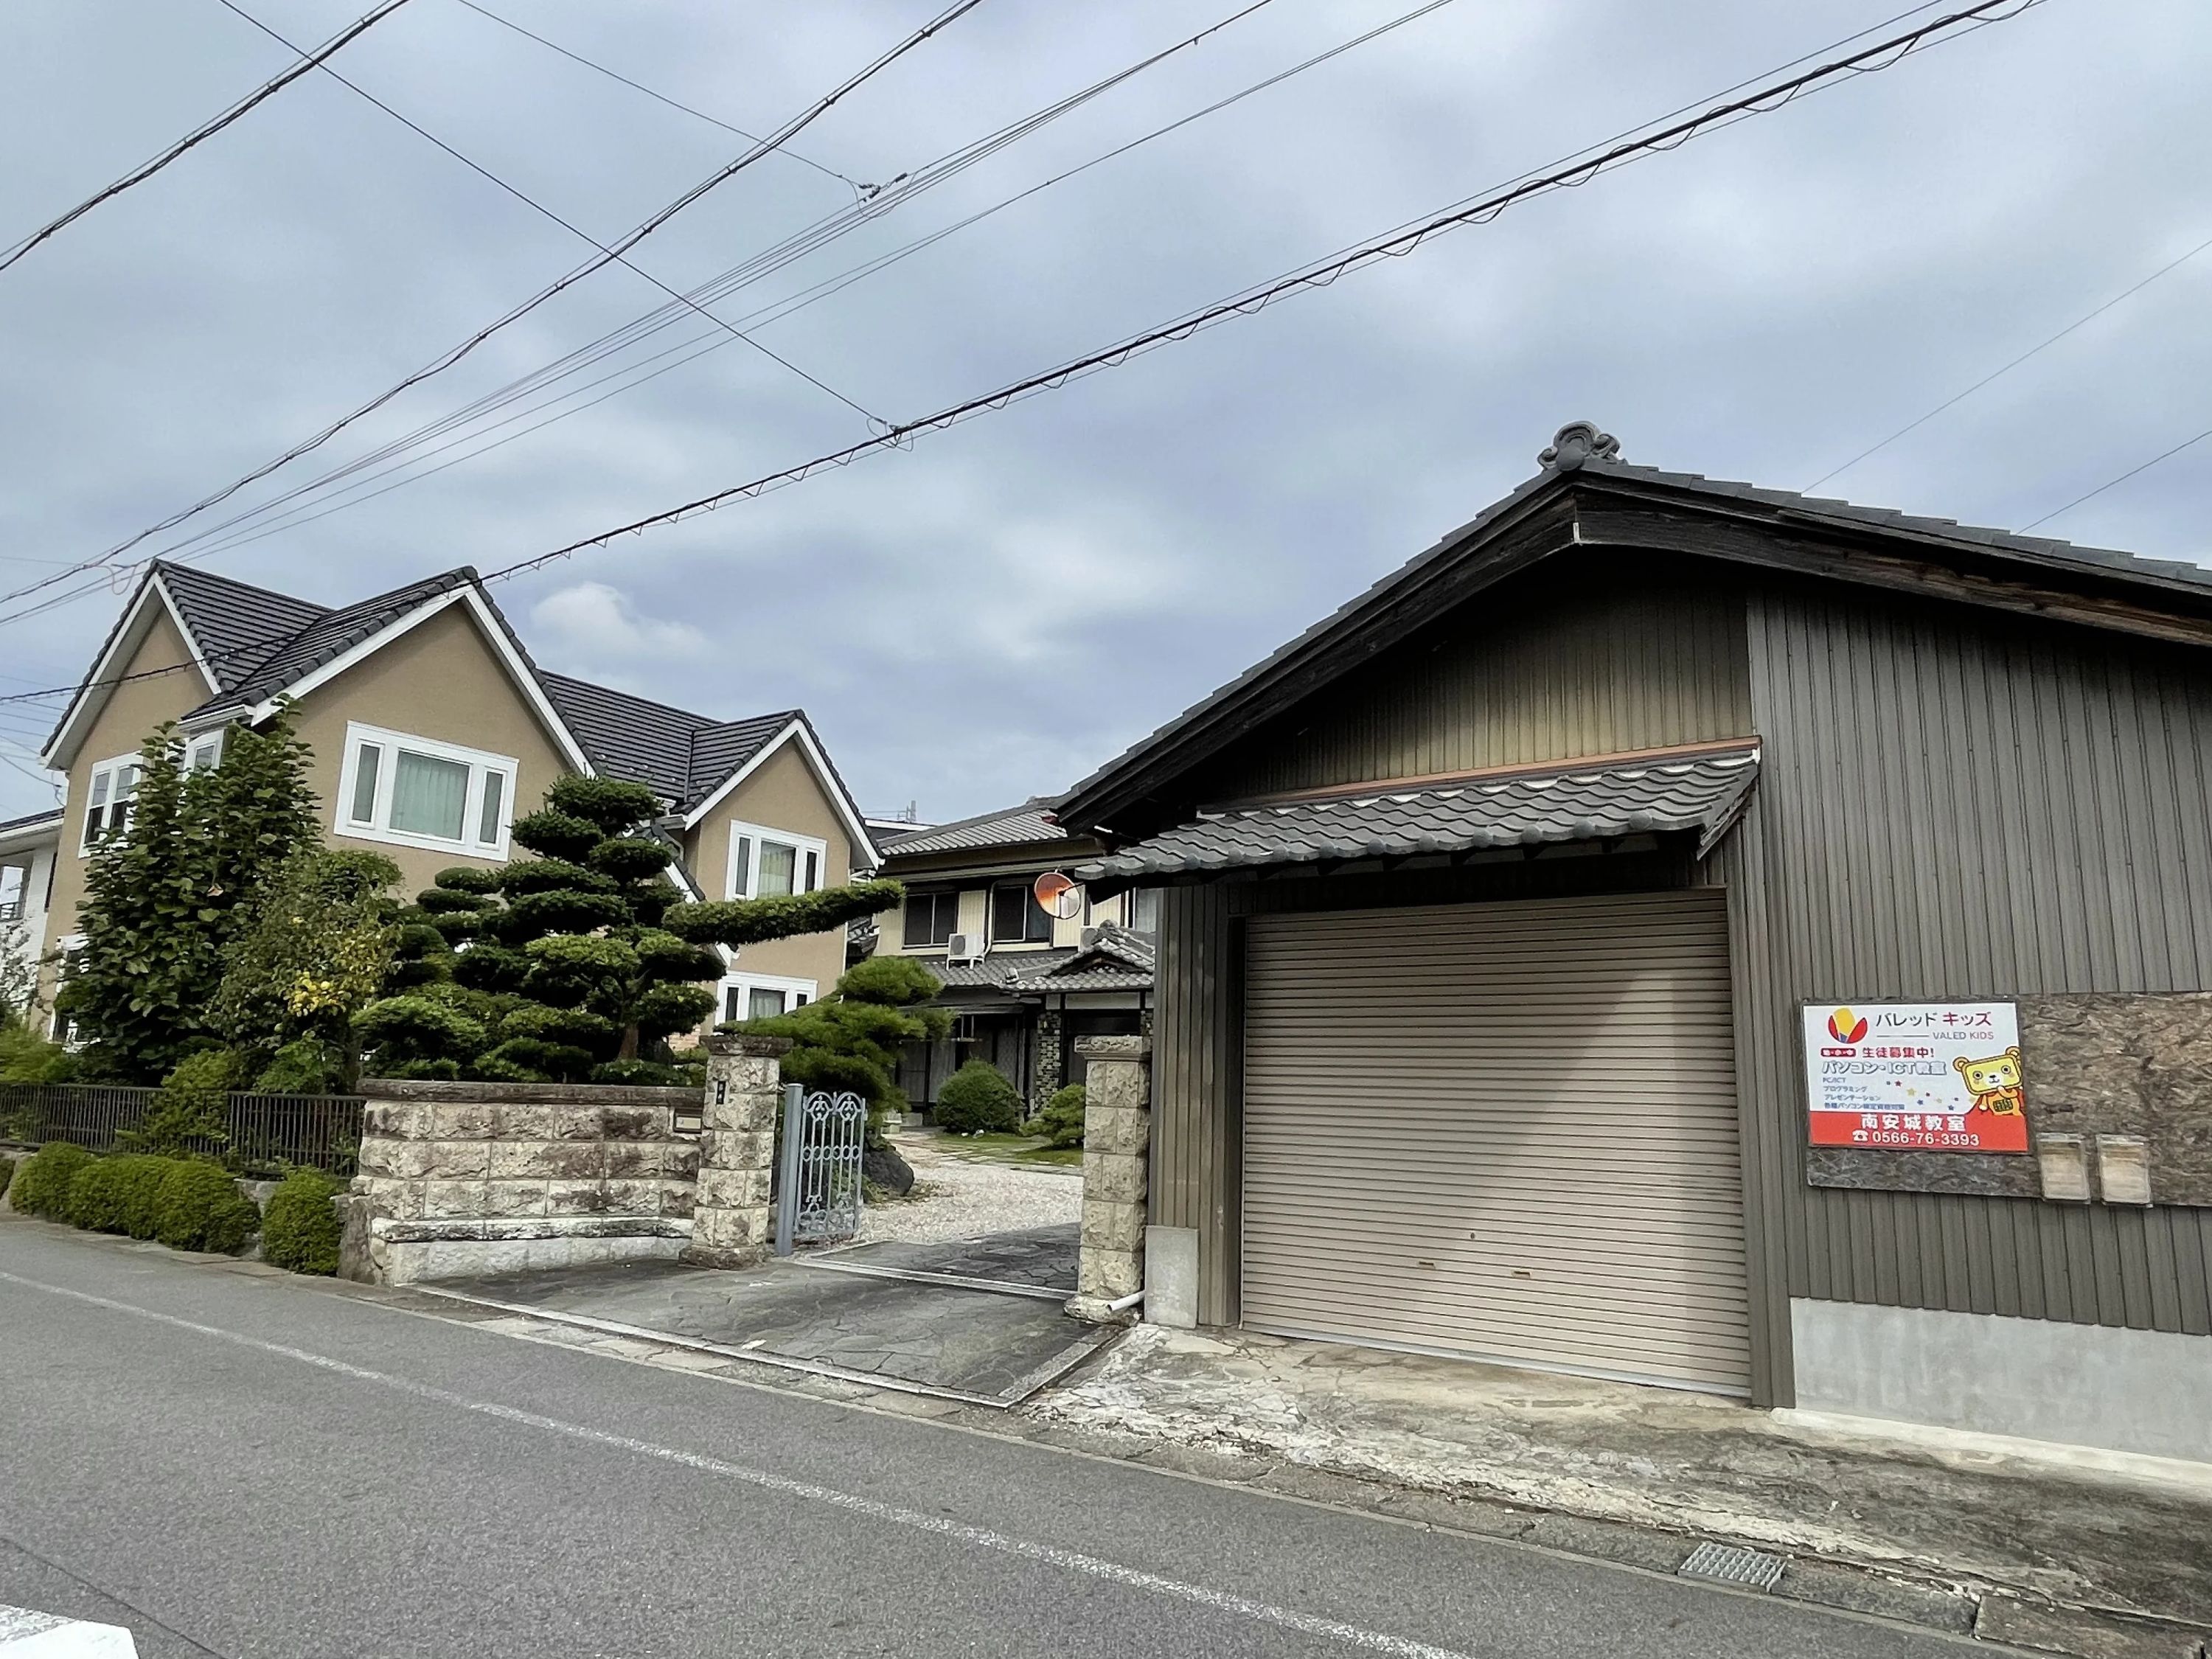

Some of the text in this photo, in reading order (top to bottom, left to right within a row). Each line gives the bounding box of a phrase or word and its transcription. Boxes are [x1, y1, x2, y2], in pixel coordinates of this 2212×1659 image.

[1876, 1012, 1992, 1026] バレッド キッズ
[1932, 1032, 1994, 1040] VALED KIDS
[1860, 1113, 1966, 1132] 南安城教室
[1871, 1131, 1980, 1147] 0566-76-3393
